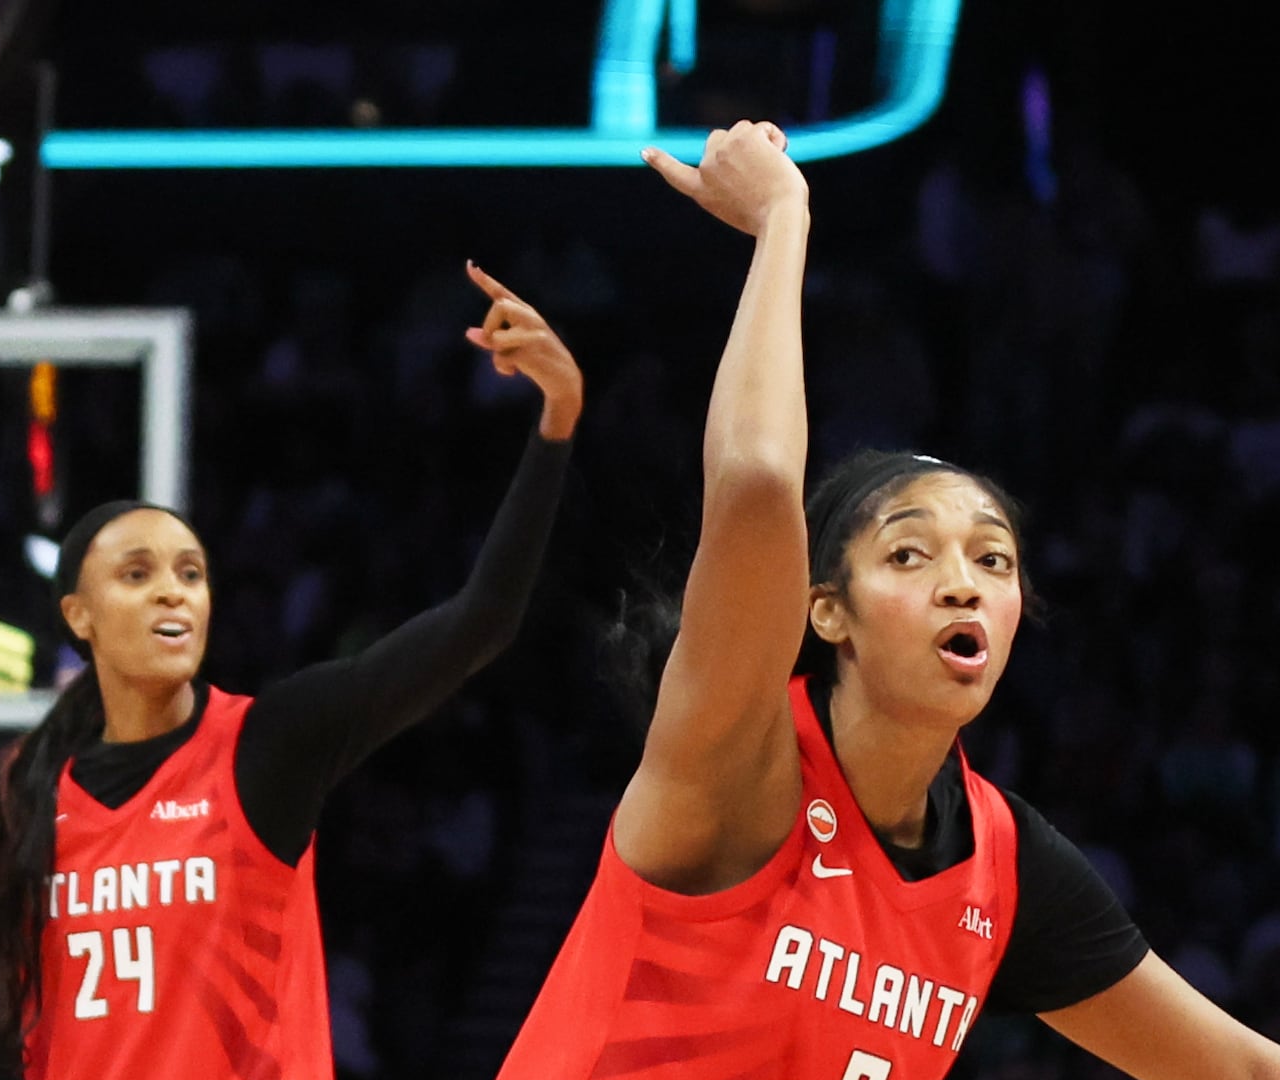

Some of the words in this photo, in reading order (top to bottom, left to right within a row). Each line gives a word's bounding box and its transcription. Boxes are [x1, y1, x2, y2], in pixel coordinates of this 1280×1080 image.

[150, 798, 211, 821] Albert
[48, 856, 216, 918] TLANTA
[958, 905, 993, 939] Albrt
[66, 925, 156, 1020] 24
